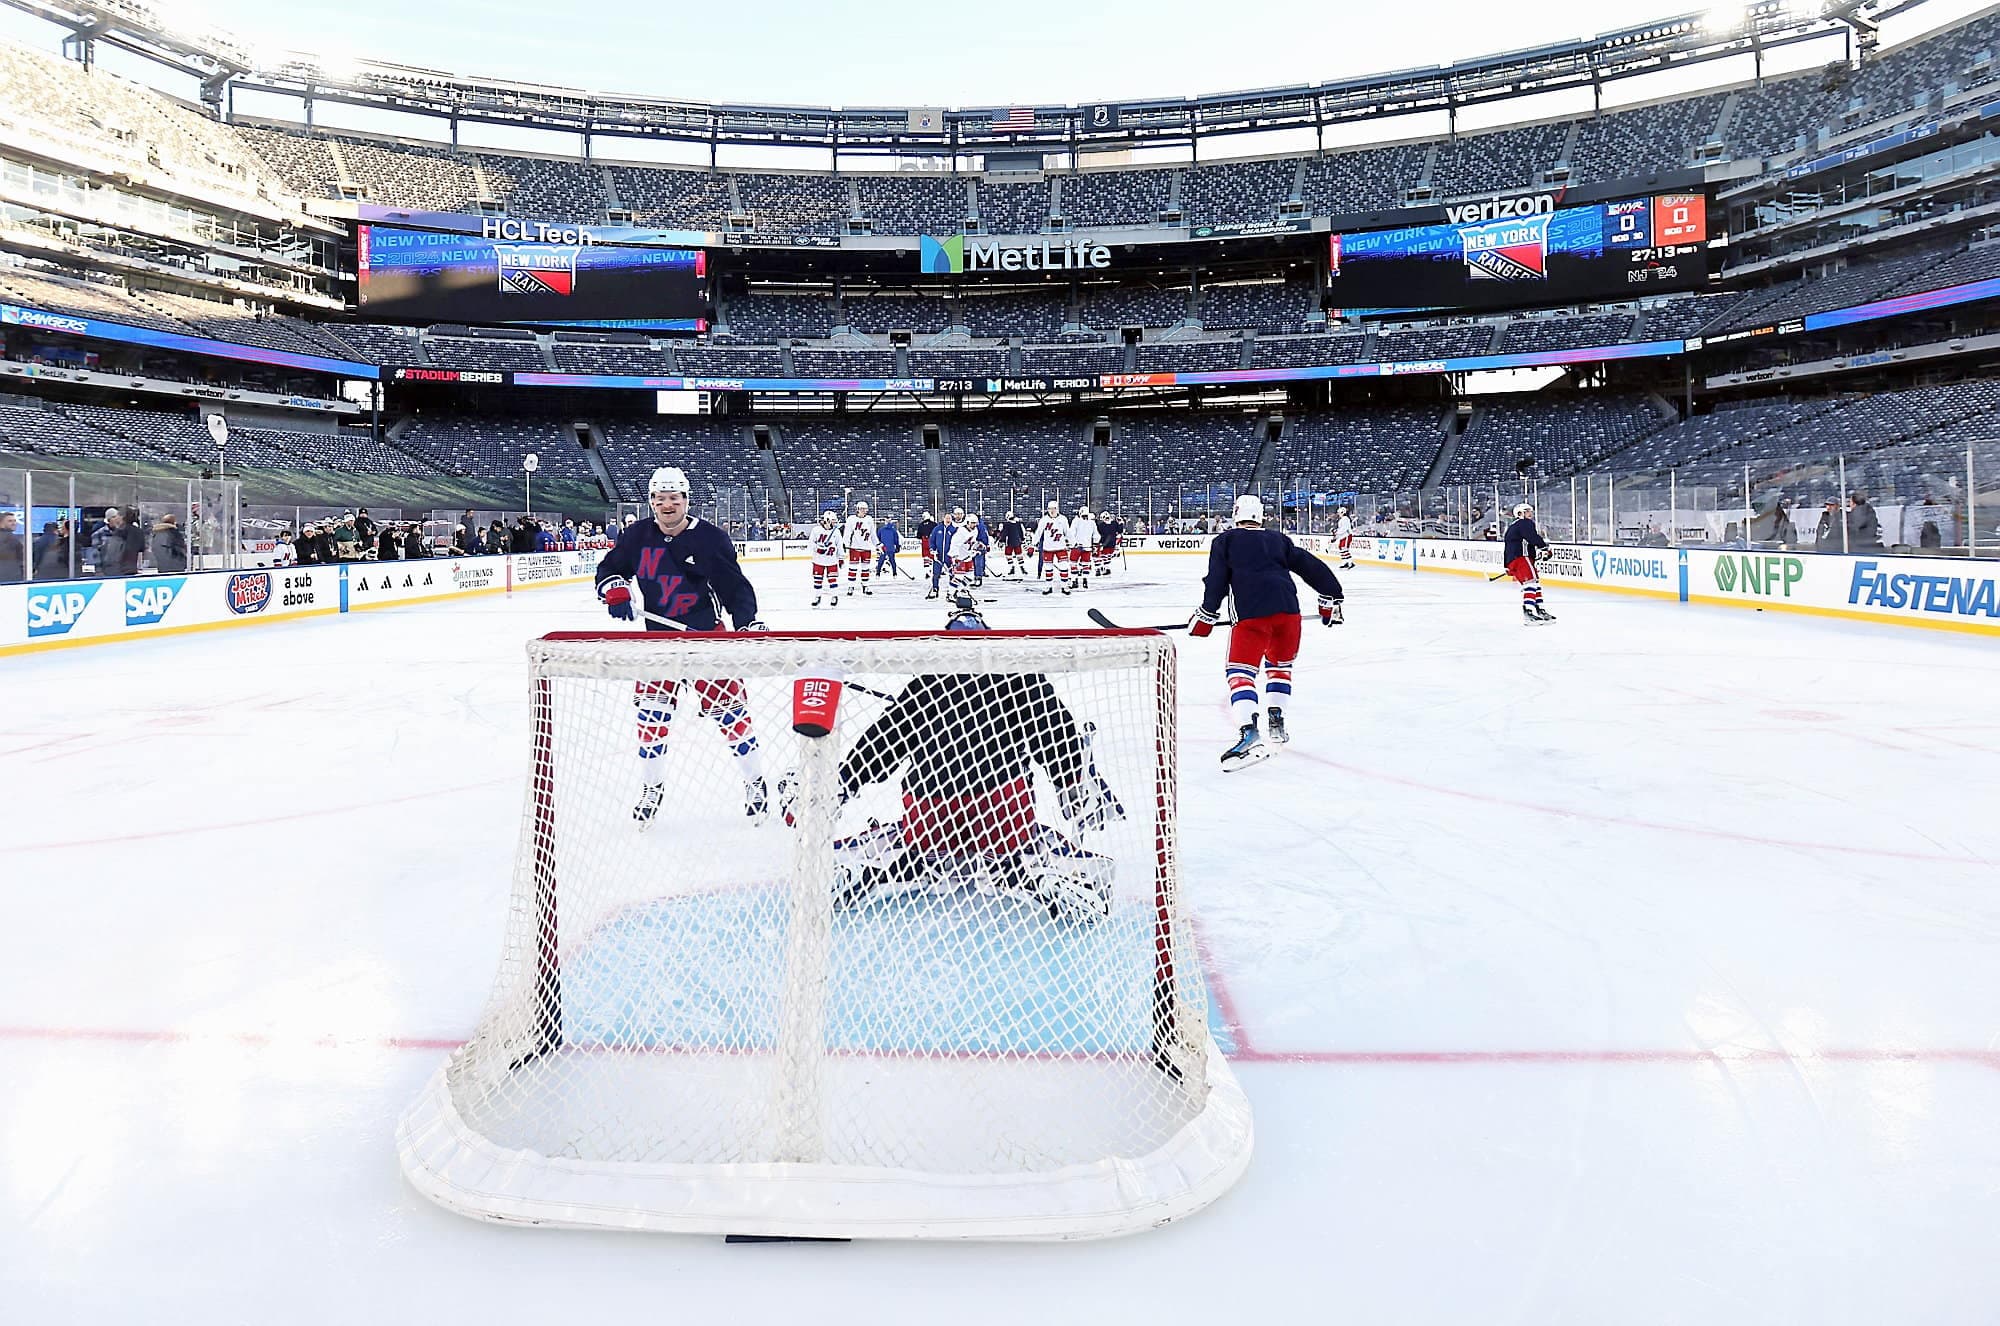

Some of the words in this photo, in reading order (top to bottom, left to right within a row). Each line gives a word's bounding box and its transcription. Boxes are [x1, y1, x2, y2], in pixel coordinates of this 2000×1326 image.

[1445, 194, 1554, 224] verizon
[1673, 207, 1689, 224] 0
[1214, 223, 1245, 232] SUPER
[1247, 221, 1274, 229] BOWL
[1240, 225, 1299, 235] CHAMPIONS
[1620, 215, 1634, 231] 0
[482, 218, 593, 246] HCLTech
[1467, 233, 1496, 250] NEW
[1502, 225, 1541, 245] YORK
[376, 236, 413, 246] NEW
[418, 234, 461, 246] YORK
[1346, 237, 1380, 253] NEW
[1384, 227, 1425, 245] YORK
[1408, 239, 1442, 255] NEW
[387, 250, 441, 265] 2024
[442, 250, 477, 262] NEW
[502, 253, 530, 266] NEW
[535, 255, 570, 268] YORK
[643, 250, 676, 263] NEW
[970, 239, 1112, 271] MetLife
[1631, 246, 1676, 262] 27:13
[20, 311, 88, 331] RANGERS
[40, 368, 68, 379] MetLife
[395, 368, 502, 383] #STADIUMSERIES
[1746, 372, 1773, 382] verizon
[940, 381, 973, 391] 27:13
[1005, 379, 1047, 390] MetLife
[1053, 378, 1089, 388] PERIOD
[1093, 378, 1097, 387] 1
[195, 388, 223, 398] verizon
[290, 398, 321, 409] HCLTech
[1120, 537, 1147, 548] BET
[1158, 537, 1200, 549] verizon
[1554, 548, 1582, 560] FEDERAL
[1560, 564, 1583, 577] UNION
[1609, 557, 1668, 579] FANDUEL
[232, 575, 267, 592] Jersey
[285, 578, 291, 589] a
[294, 573, 312, 588] sub
[637, 547, 699, 618] NYR
[1741, 556, 1804, 597] NFP
[1849, 561, 2000, 618] FASTENA
[126, 586, 173, 617] SAP
[283, 591, 314, 606] above
[28, 592, 85, 628] SAP
[803, 681, 831, 693] BIO
